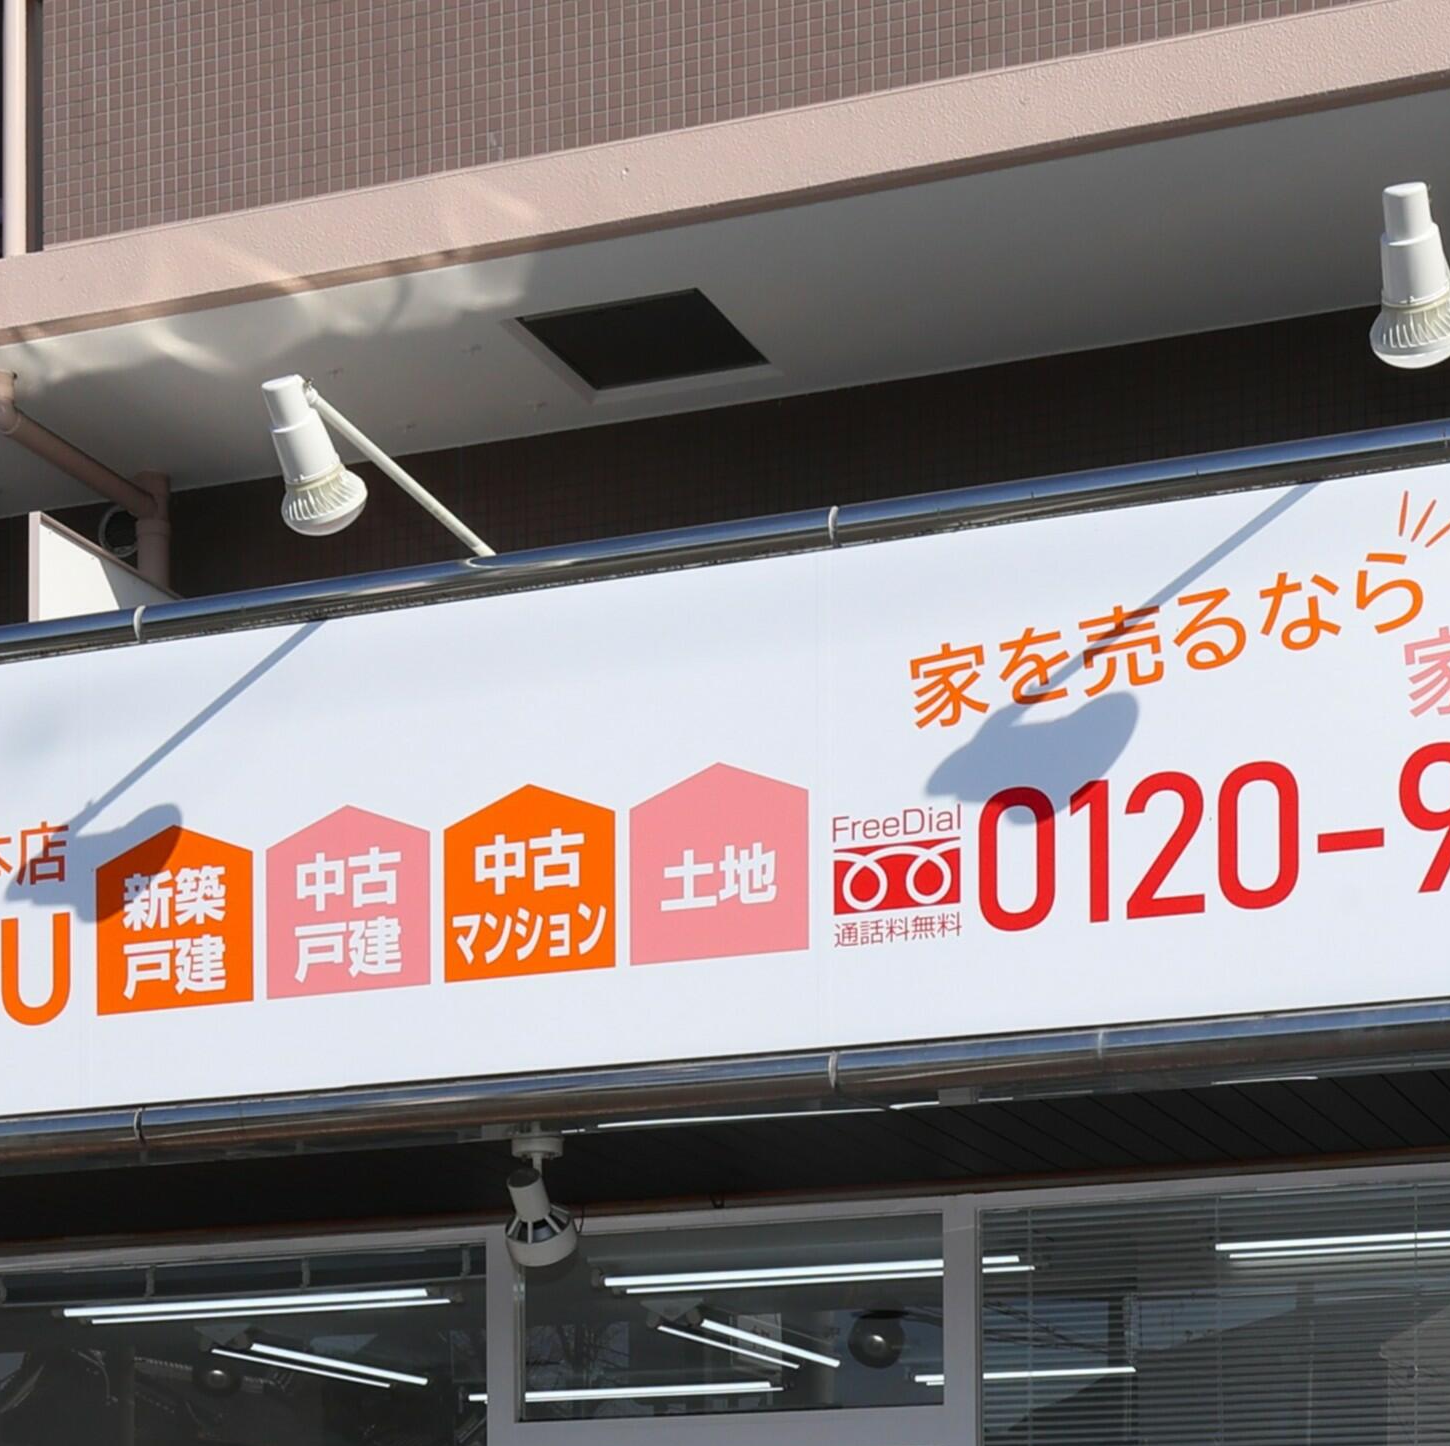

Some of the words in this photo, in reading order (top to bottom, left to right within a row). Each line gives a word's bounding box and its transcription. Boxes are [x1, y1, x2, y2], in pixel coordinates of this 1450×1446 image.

[910, 551, 1425, 729] 家を売るなら
[832, 803, 962, 842] FreeDial
[294, 845, 402, 911] 中古
[473, 827, 586, 896] 中古
[659, 847, 777, 914] 土地
[123, 866, 227, 933] 新築
[832, 912, 963, 949] 通話料無料
[123, 928, 227, 999] 戸建
[294, 916, 402, 983] 戸建
[451, 902, 608, 965] マンション
